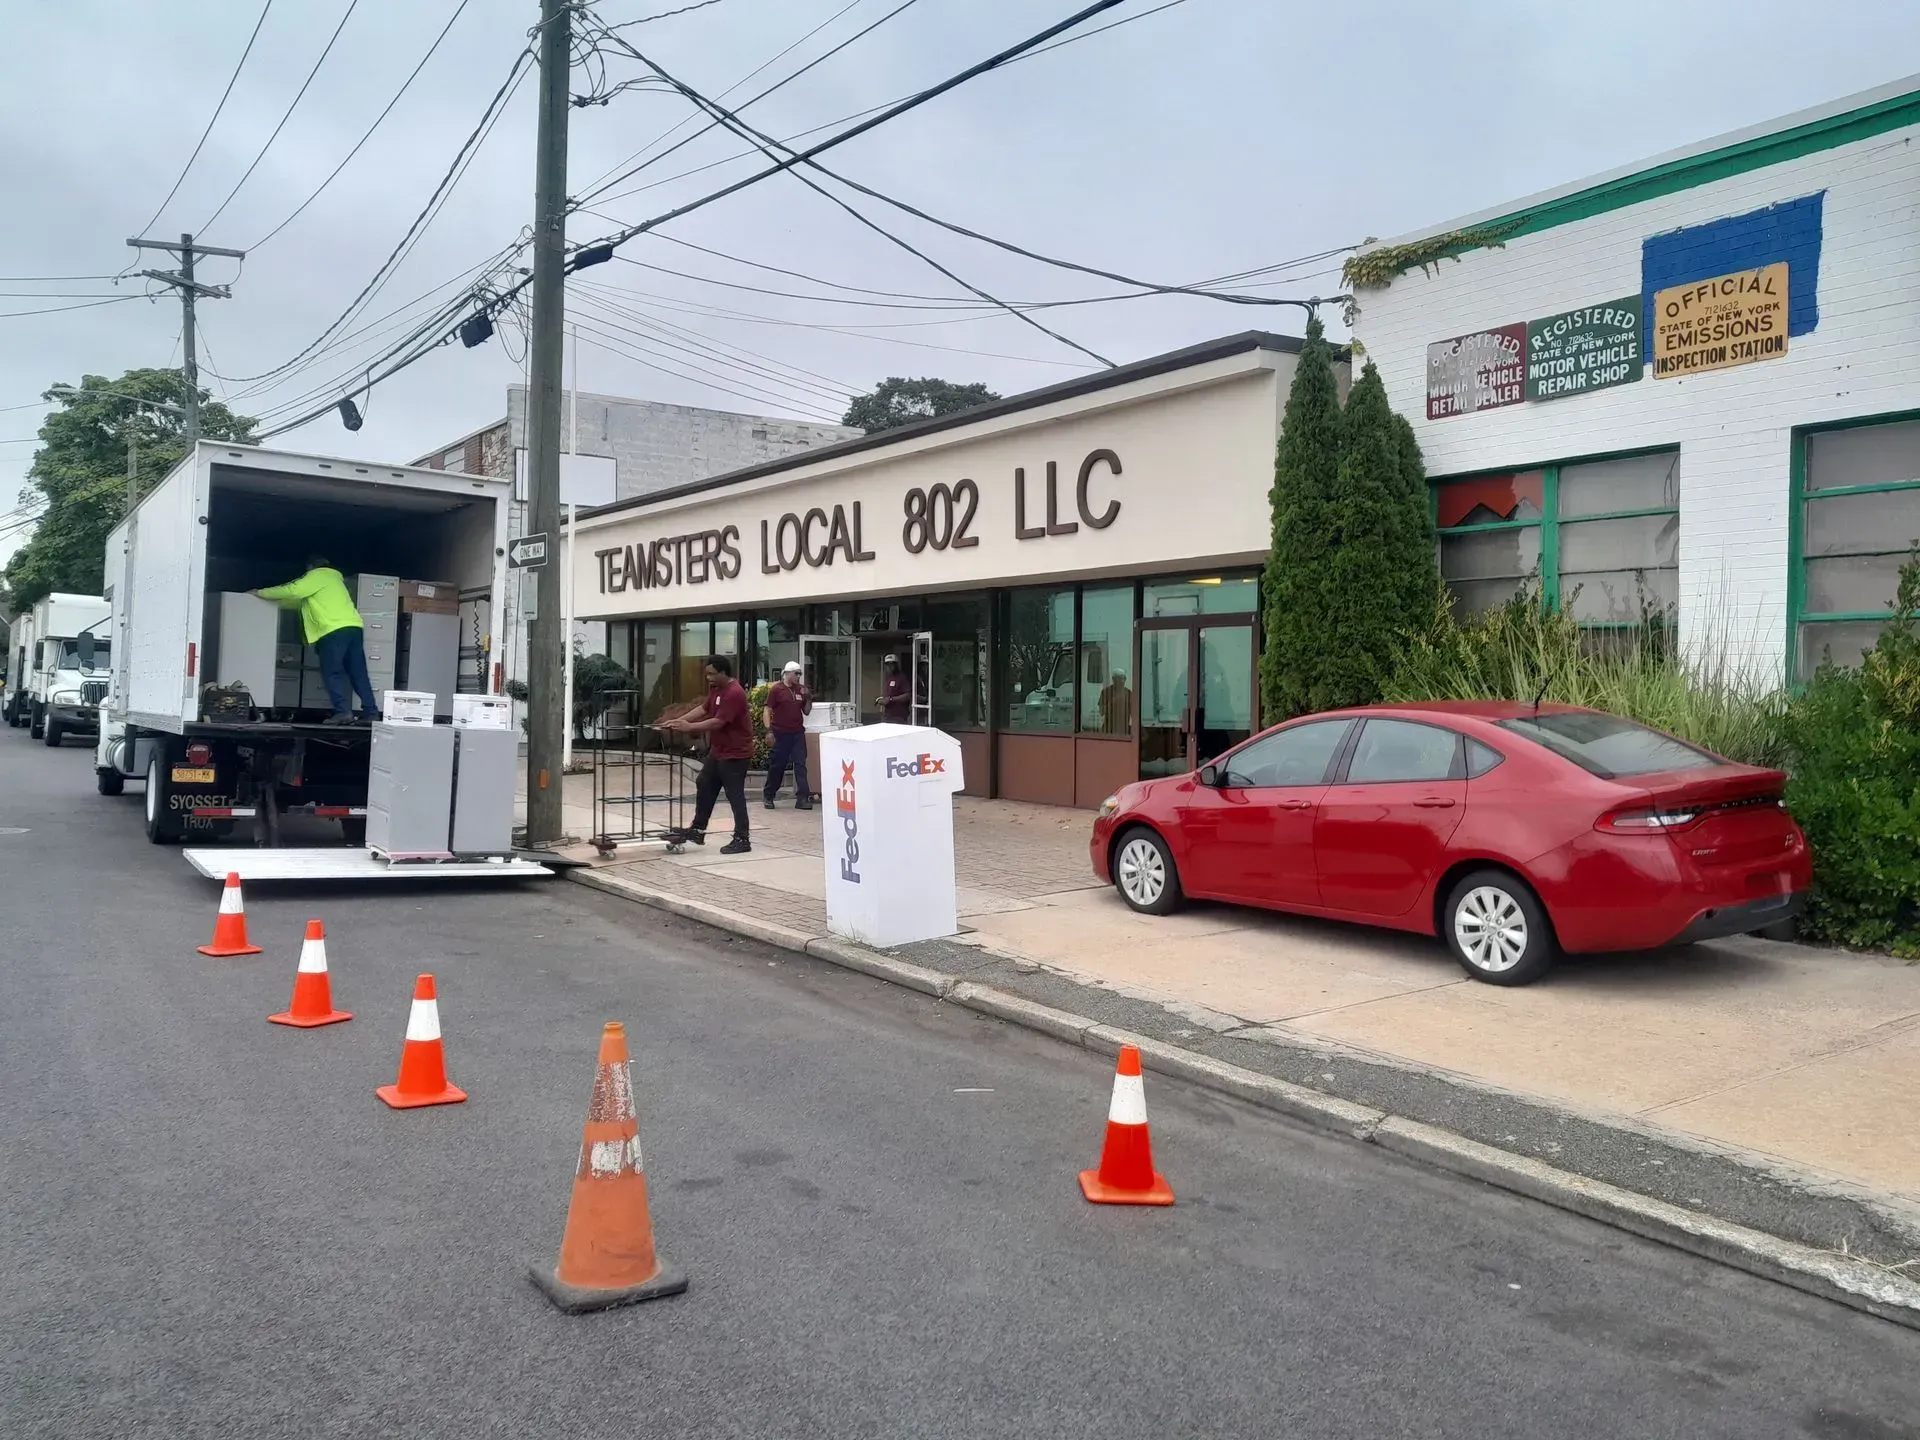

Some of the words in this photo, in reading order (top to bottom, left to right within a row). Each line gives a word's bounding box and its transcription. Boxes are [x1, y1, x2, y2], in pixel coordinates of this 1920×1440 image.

[1665, 276, 1777, 318] OFFICIAL
[1704, 300, 1740, 315] 7121632
[1531, 308, 1636, 351] REGISTERED
[1659, 320, 1693, 334] STATE
[1697, 315, 1713, 327] OF
[1716, 309, 1743, 323] NEW
[1747, 301, 1781, 316] YORK
[1666, 315, 1773, 351] EMISSIONS
[1529, 356, 1575, 380] MOTOR
[1579, 342, 1638, 370] VEHICLE
[1531, 347, 1562, 361] STATE
[1565, 344, 1579, 355] OF
[1581, 338, 1605, 351] NEW
[1608, 331, 1636, 344] YORK
[1656, 345, 1727, 374] INSPECTION
[1730, 335, 1784, 360] STATION
[1475, 366, 1523, 389] VEHICLE
[1538, 372, 1587, 396] REPAIR
[1591, 363, 1630, 385] SHOP
[594, 525, 742, 594] TEAMSTERS
[760, 500, 876, 576] LOCAL
[903, 478, 980, 554] 802
[1014, 448, 1123, 540] LLC
[520, 545, 531, 558] ONE
[532, 543, 543, 556] WAY
[886, 753, 945, 779] FedEx
[170, 794, 227, 810] SYOSSET
[836, 758, 861, 884] FedEx
